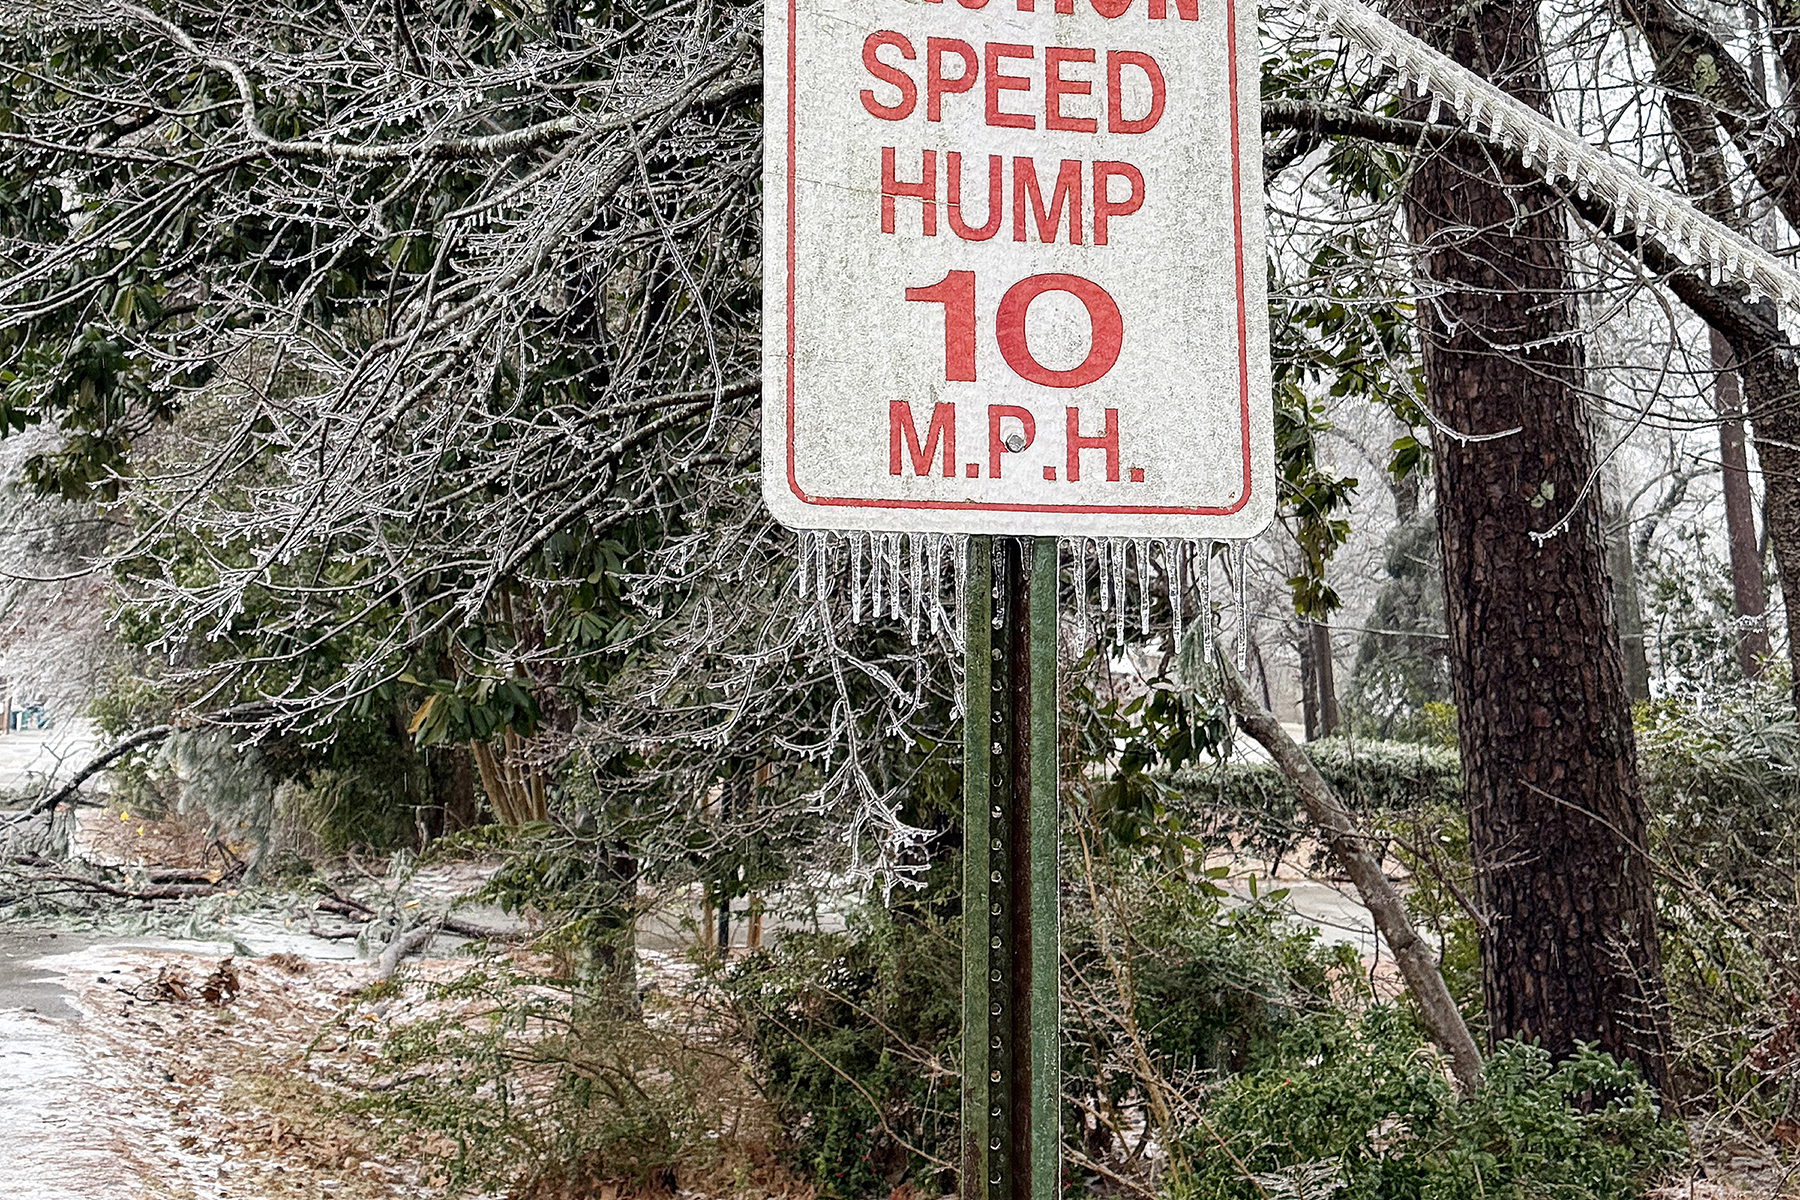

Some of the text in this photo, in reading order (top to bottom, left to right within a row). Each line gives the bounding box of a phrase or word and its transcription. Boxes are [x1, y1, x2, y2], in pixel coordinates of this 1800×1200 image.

[859, 29, 1166, 135] SPEED
[880, 146, 1146, 246] HUMP
[904, 269, 1124, 389] 10
[888, 400, 1145, 483] M.P.H.
